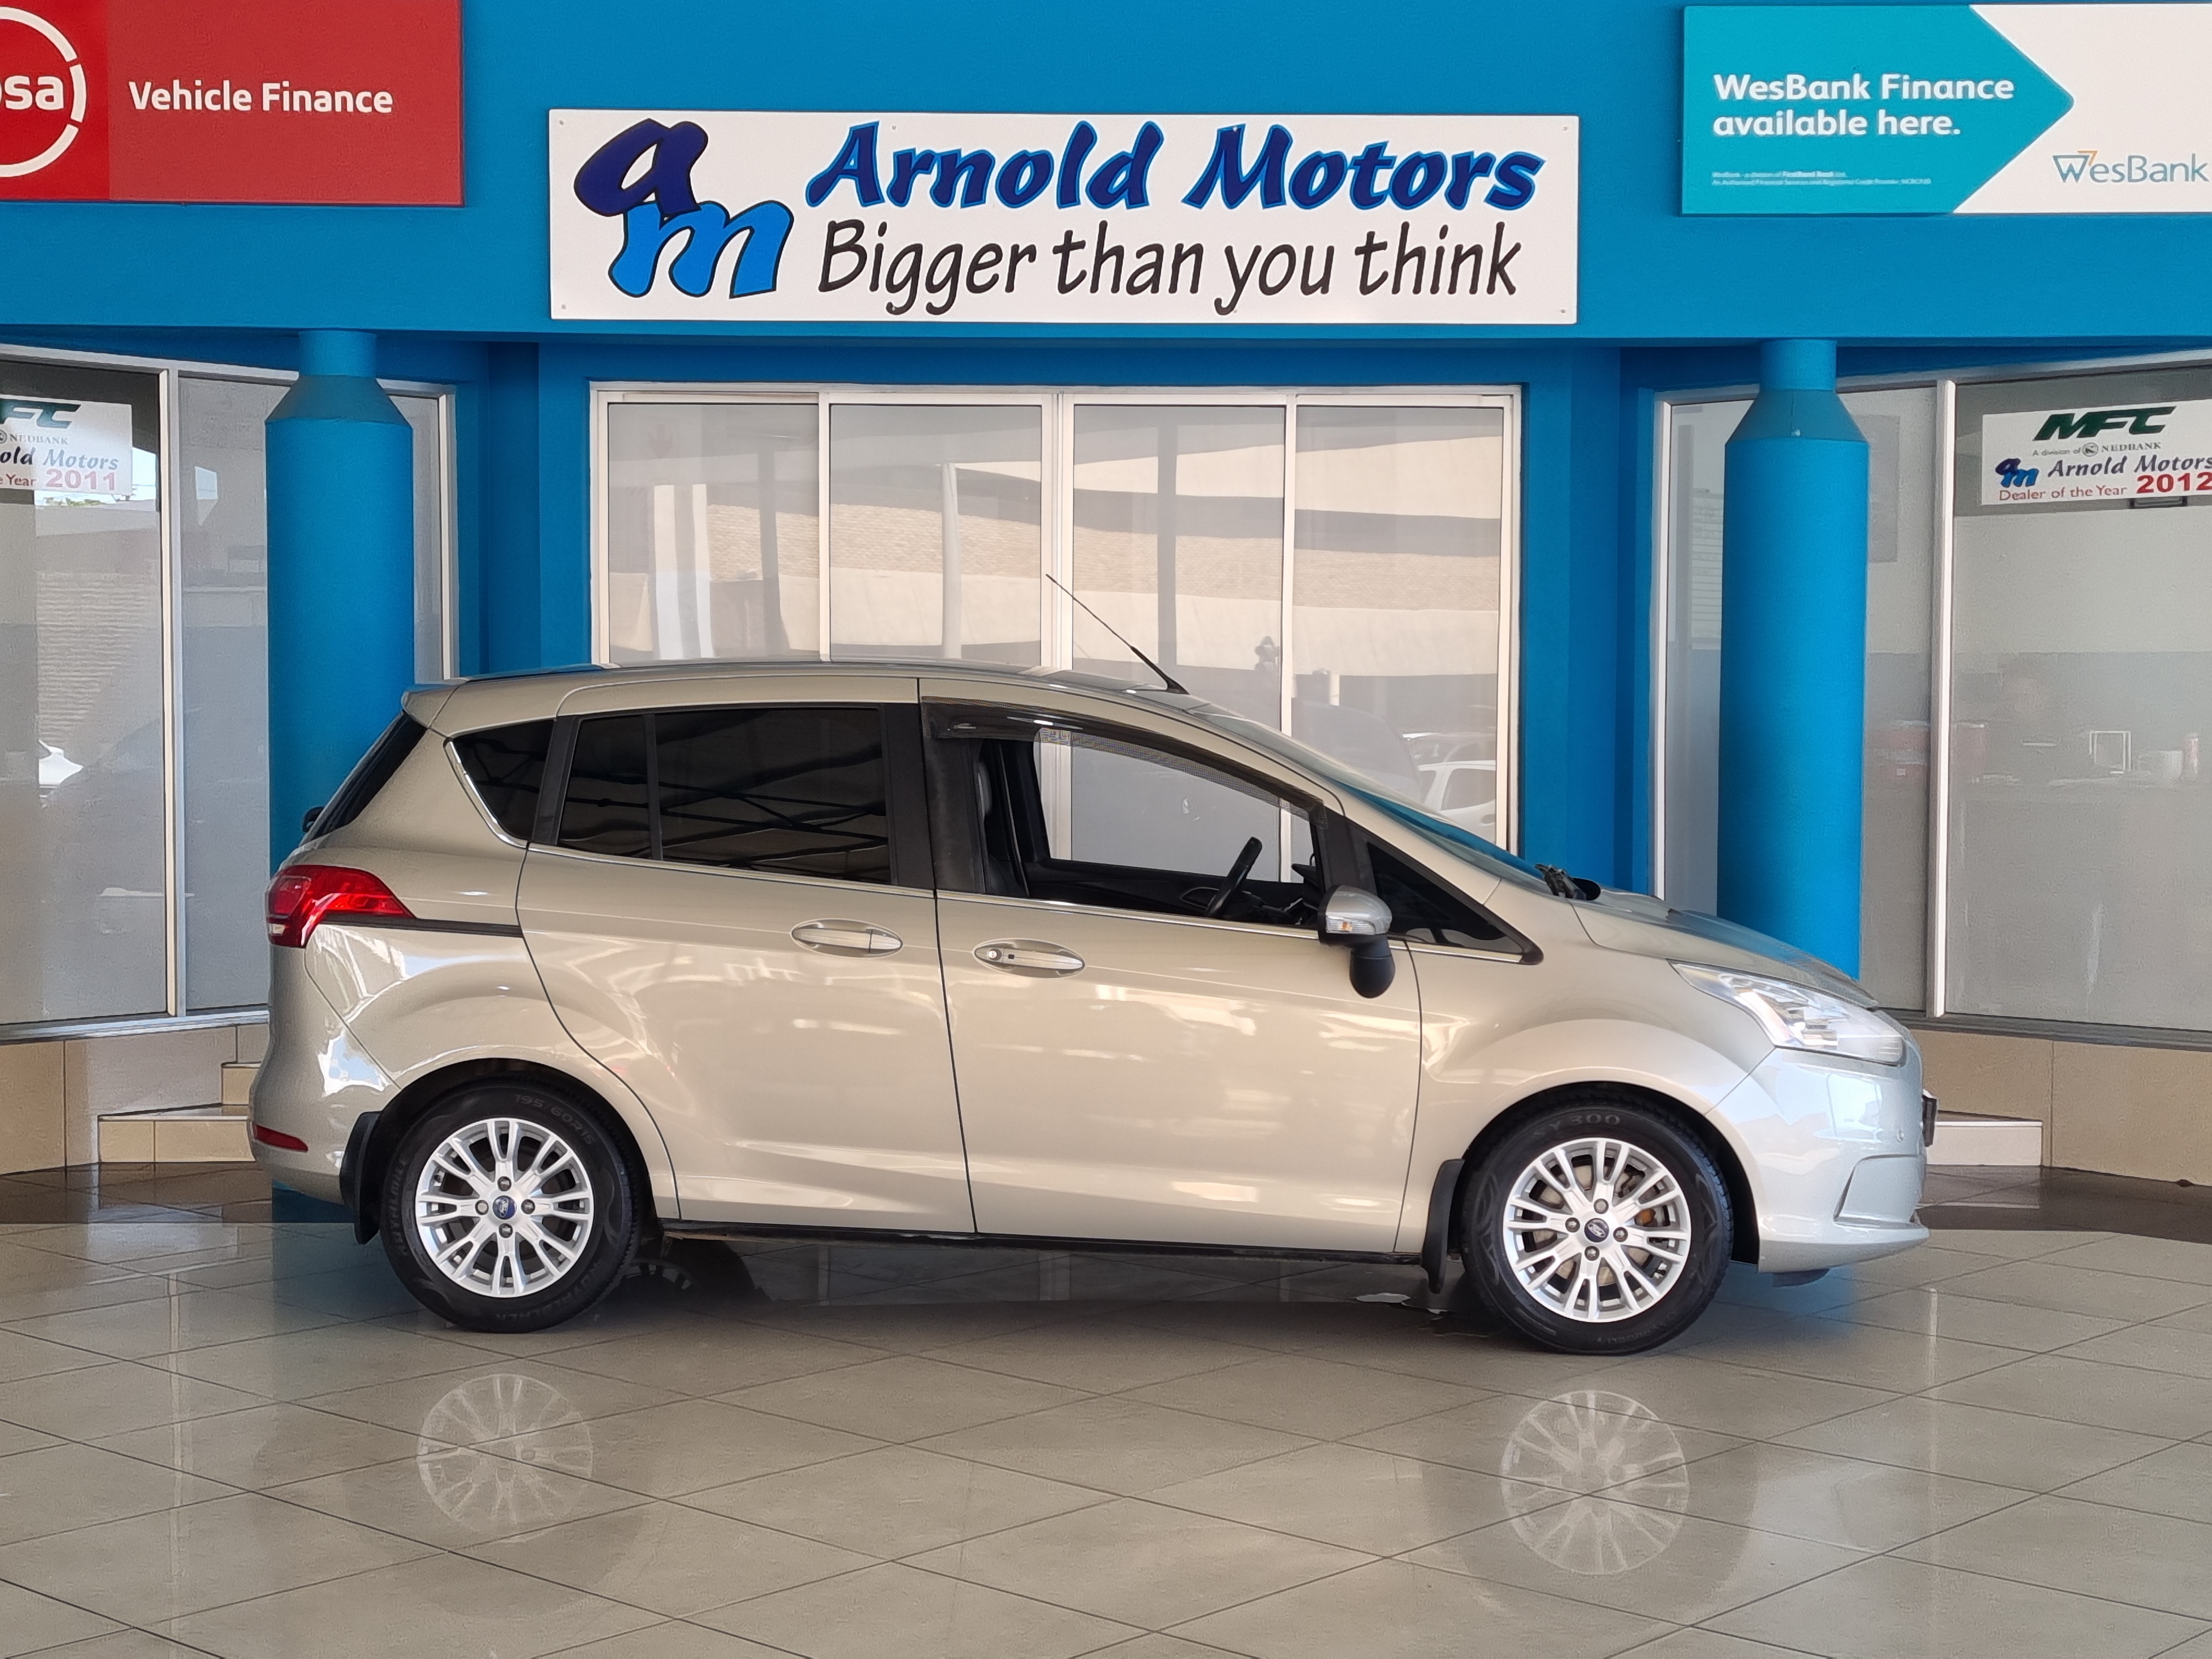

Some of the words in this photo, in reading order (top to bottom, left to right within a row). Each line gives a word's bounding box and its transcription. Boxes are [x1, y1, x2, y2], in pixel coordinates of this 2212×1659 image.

[0, 75, 64, 110] sa
[128, 80, 252, 111] Vehicle
[262, 81, 393, 113] Finance
[1713, 74, 1870, 101] WesBank
[1881, 74, 2015, 100] Finance
[1713, 110, 1868, 137] available
[1878, 110, 1961, 136] here.
[805, 120, 1165, 210] Arnold
[1181, 123, 1547, 211] Motors
[2052, 151, 2210, 183] WesBank
[818, 219, 1037, 315] Bigger
[1052, 220, 1204, 295] than
[1214, 244, 1335, 315] you
[1354, 221, 1521, 296] think
[2032, 405, 2177, 442] MFC
[43, 449, 119, 470] Motors
[2101, 442, 2162, 453] NEDBANK
[6, 473, 37, 487] Year
[46, 469, 115, 491] 2011
[2047, 455, 2128, 478] Arnold
[2134, 454, 2212, 473] Motors
[1999, 489, 2046, 501] Dealer
[2051, 486, 2066, 499] of
[2070, 486, 2094, 498] the
[2096, 484, 2128, 496] Year
[2136, 471, 2212, 494] 2012
